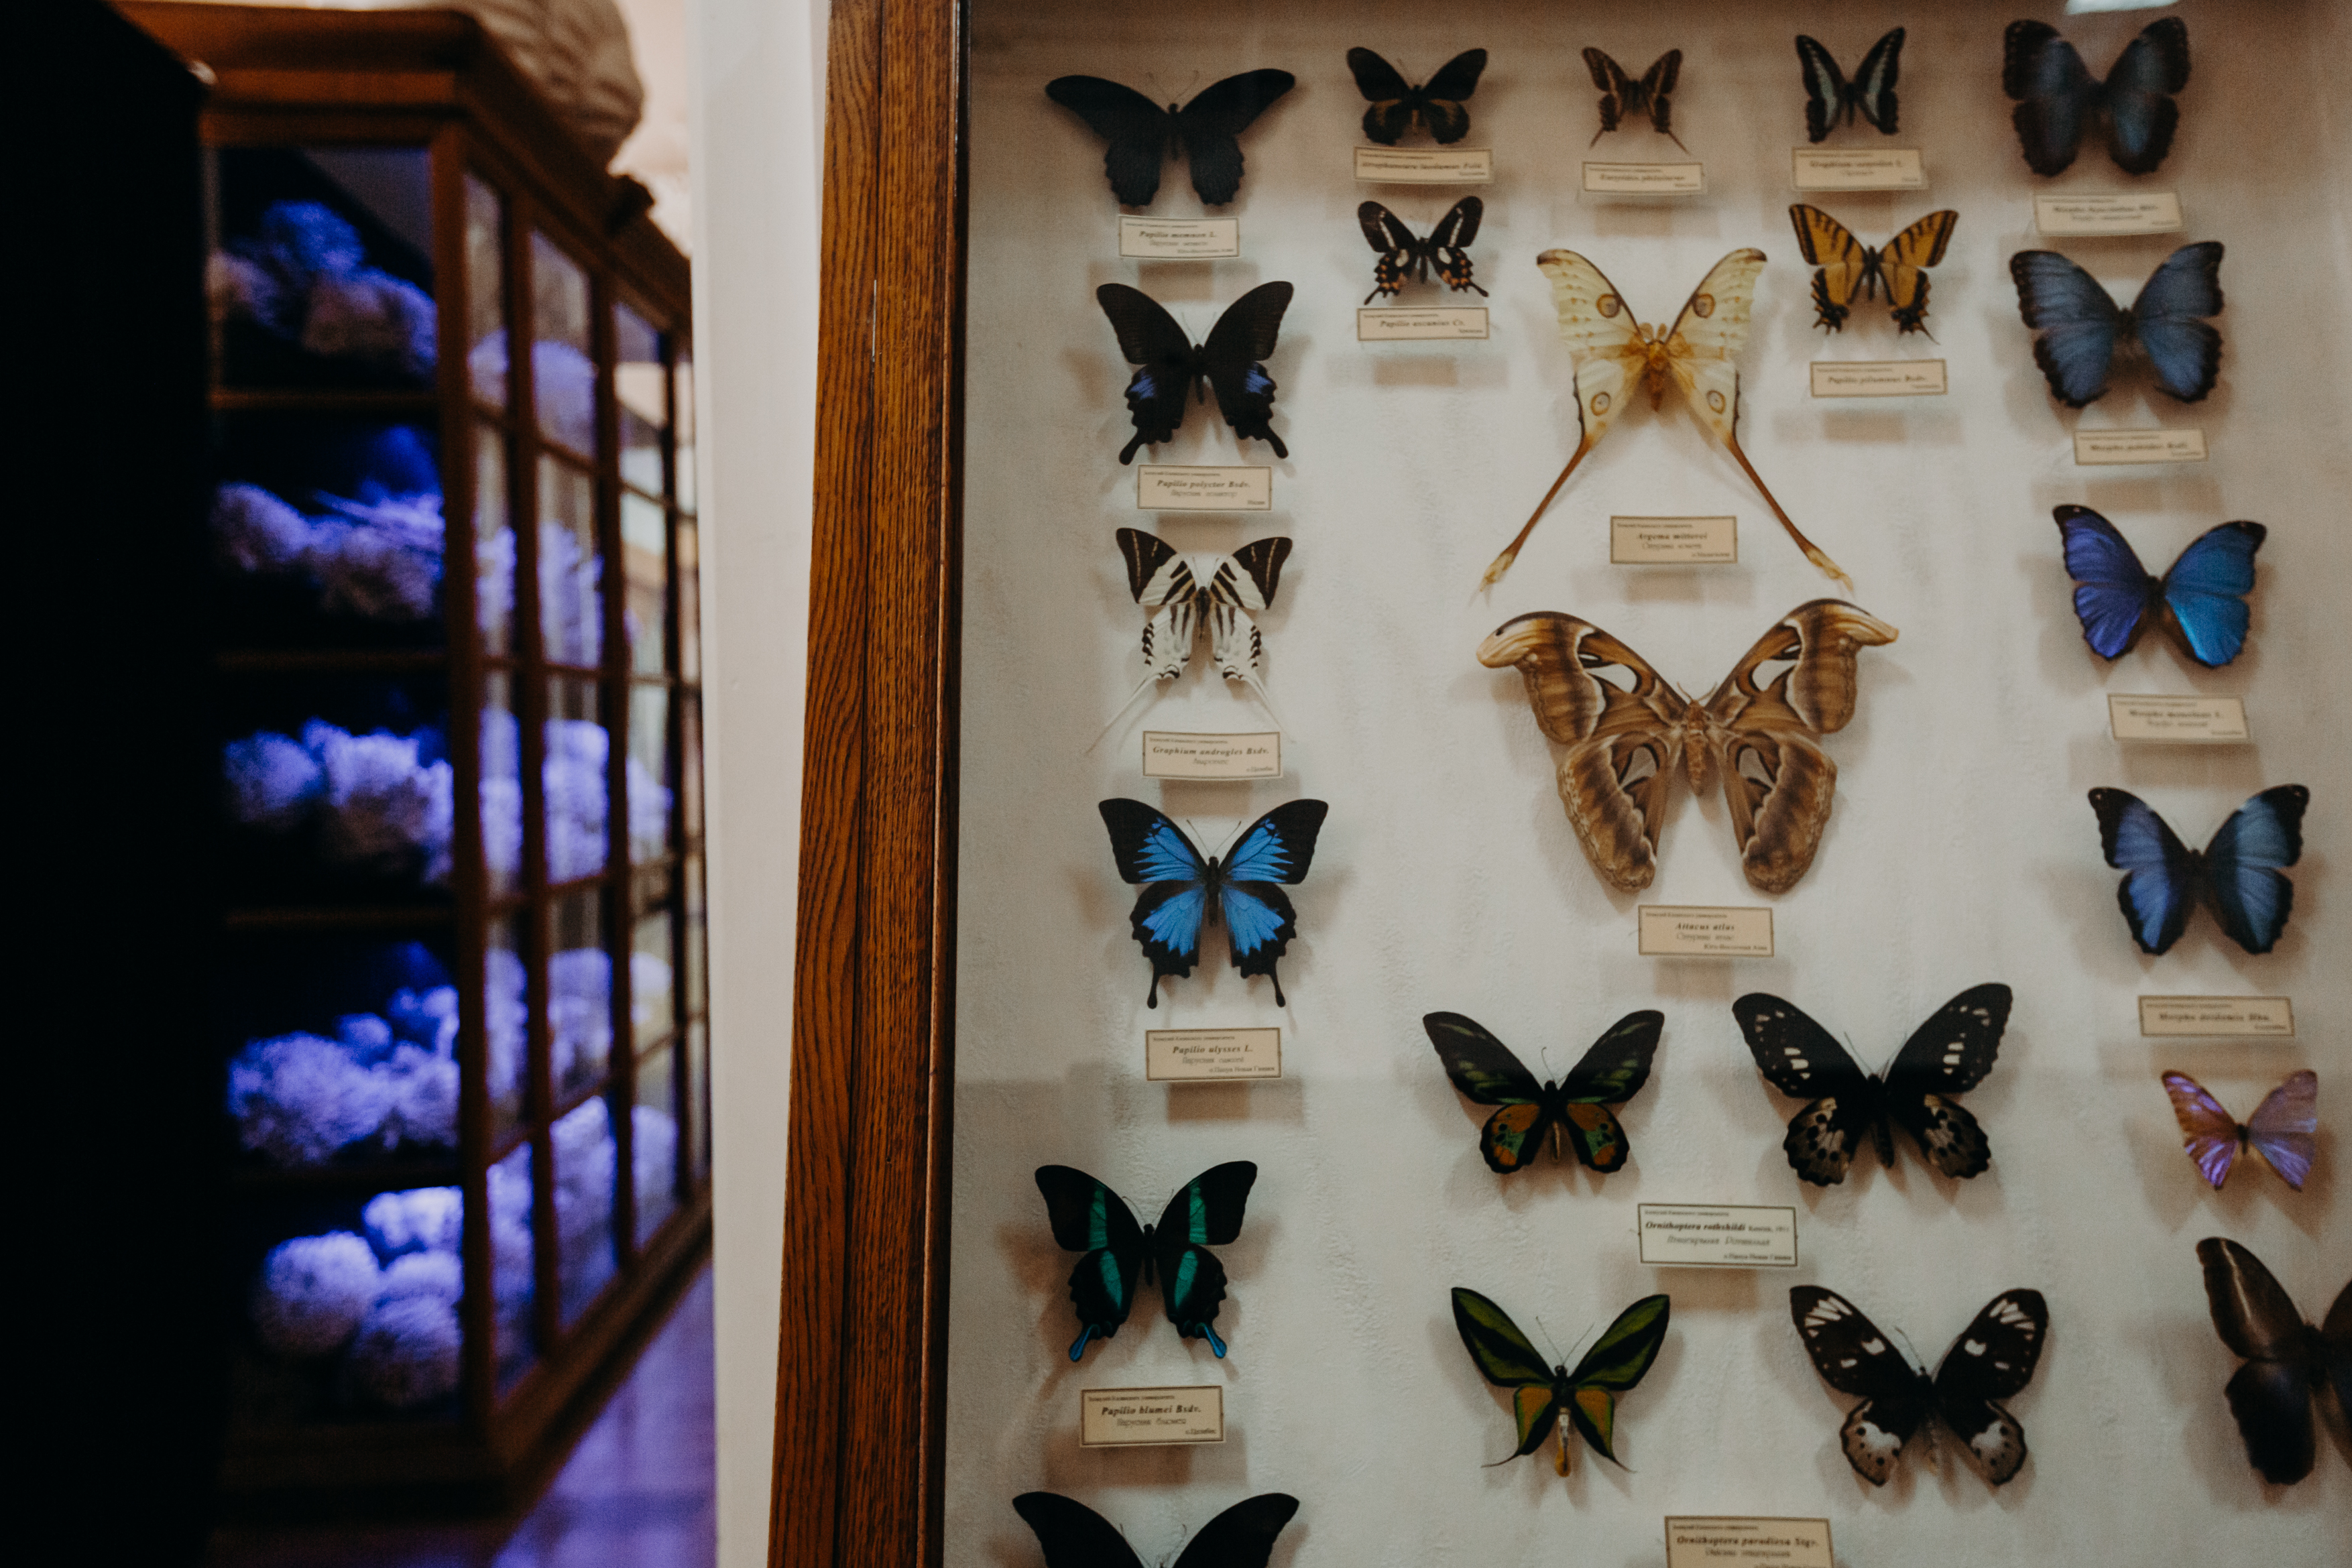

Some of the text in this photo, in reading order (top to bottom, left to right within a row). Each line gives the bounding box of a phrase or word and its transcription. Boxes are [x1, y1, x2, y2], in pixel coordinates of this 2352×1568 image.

[1157, 479, 1187, 488] Papilio
[1153, 746, 1197, 756] Graphium
[1173, 1044, 1253, 1055] Papilio ulysses L.
[1645, 1221, 1701, 1231] Ornithoptera
[1102, 1406, 1136, 1417] Papilio
